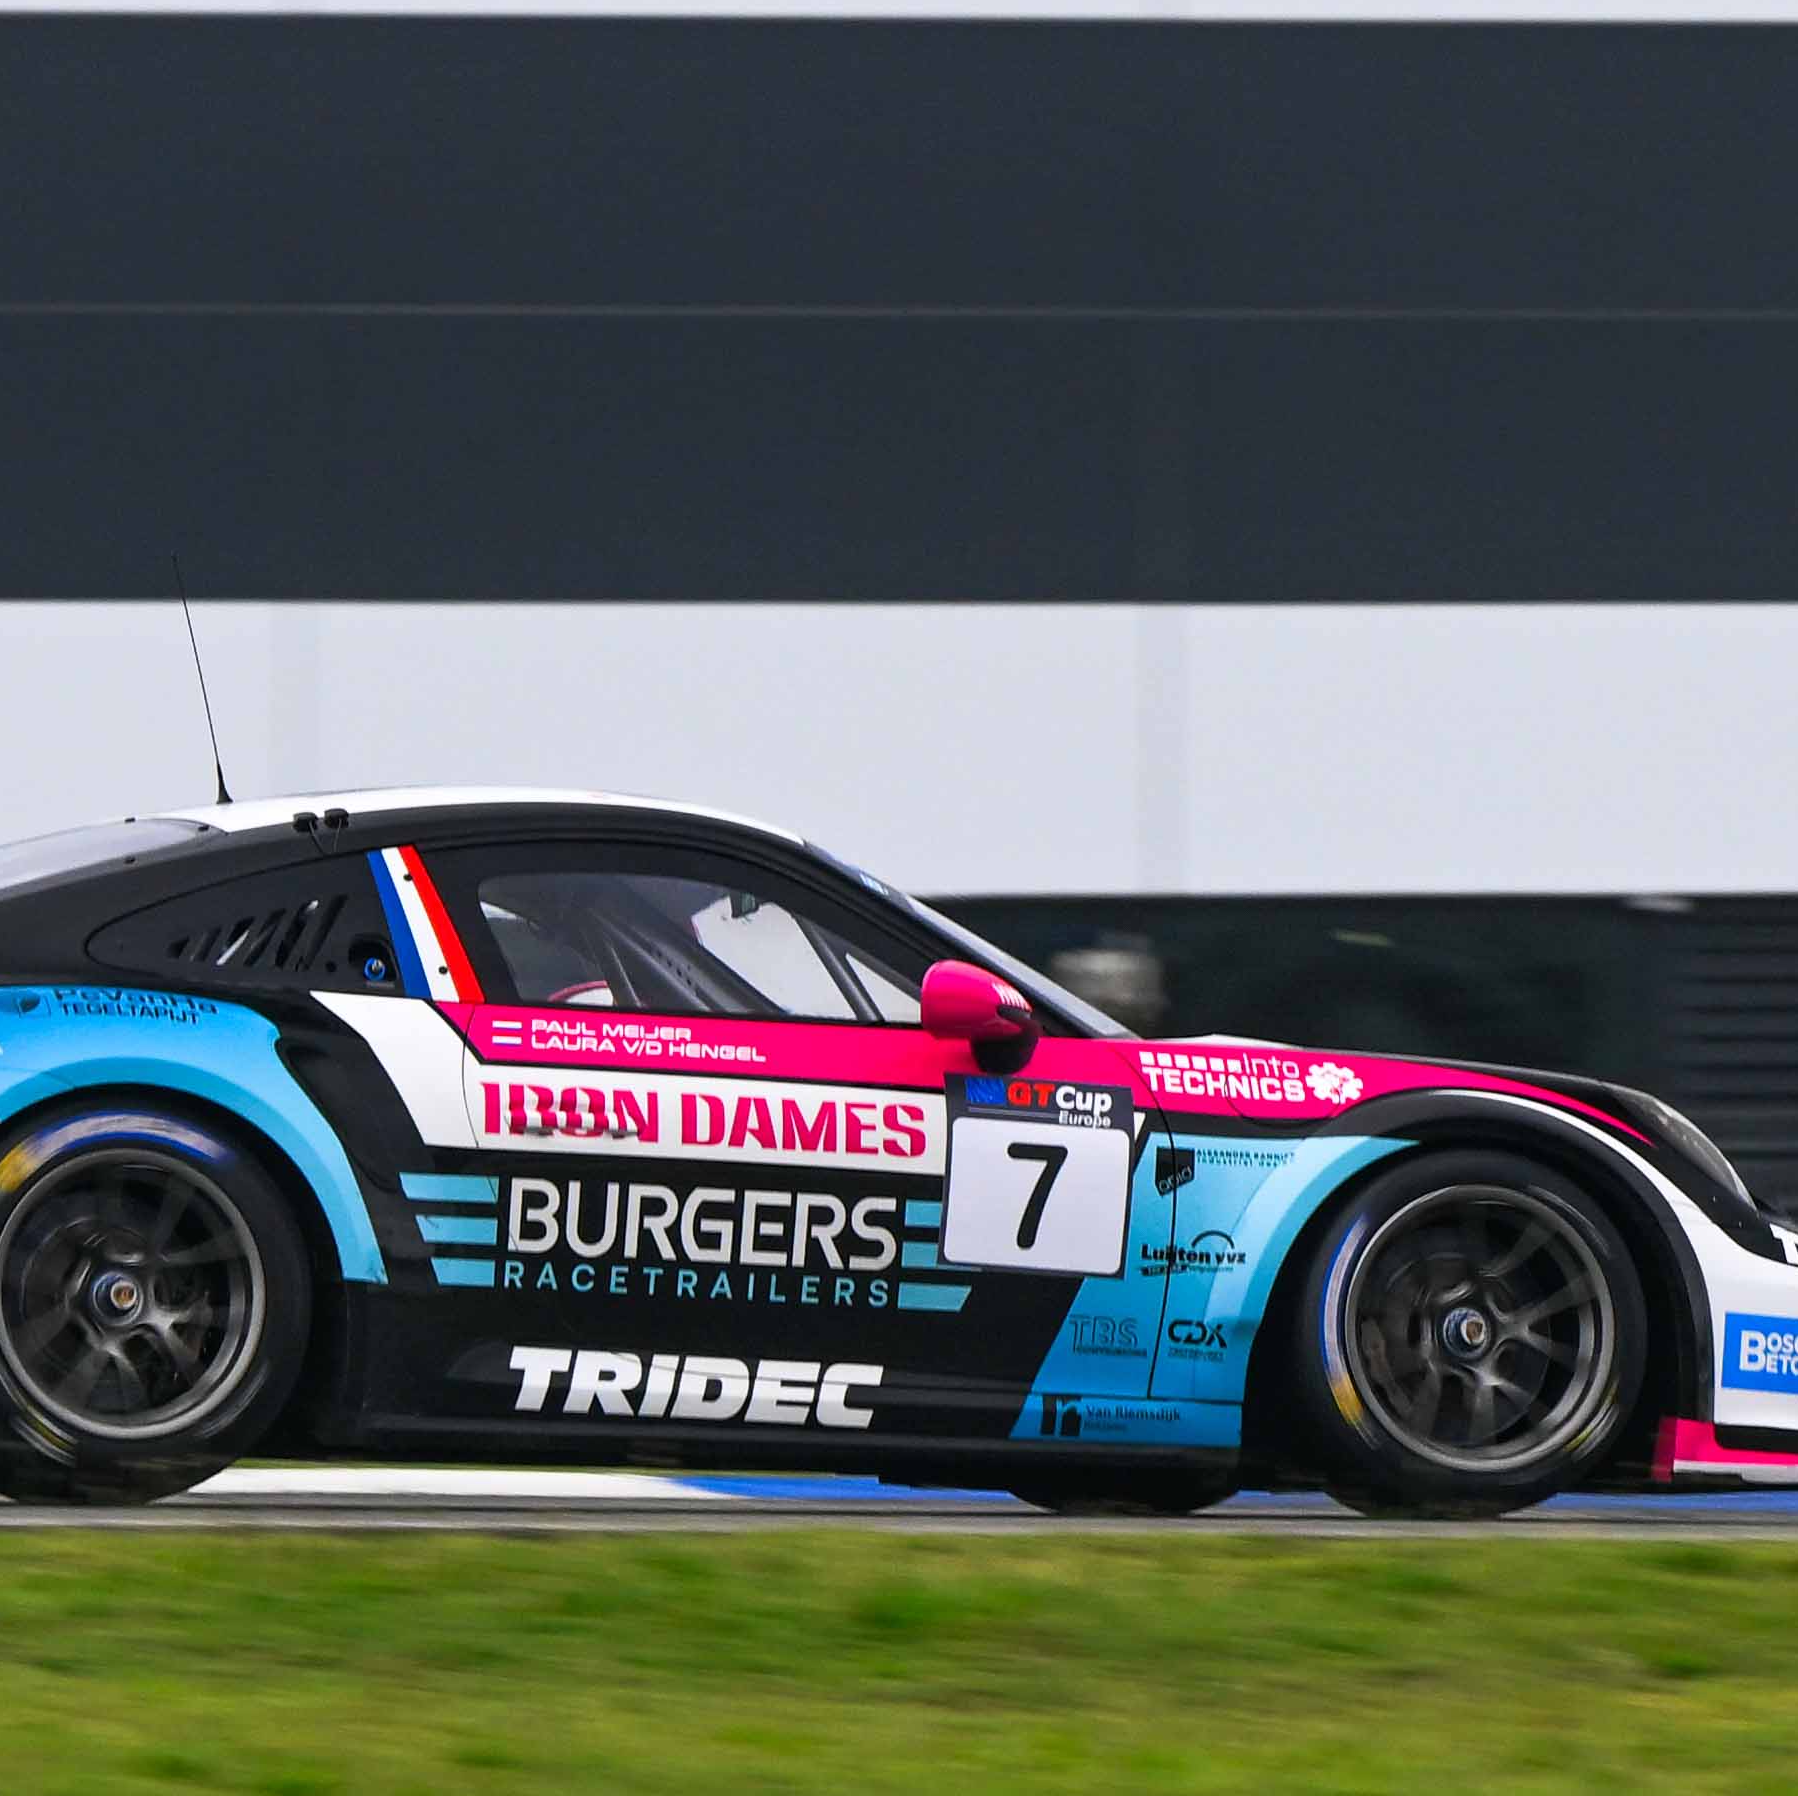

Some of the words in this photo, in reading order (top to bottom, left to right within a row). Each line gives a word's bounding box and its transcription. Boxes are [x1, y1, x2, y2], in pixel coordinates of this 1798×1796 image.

[531, 1019, 596, 1036] PAUL
[603, 1023, 691, 1041] MEIJER
[531, 1034, 616, 1052] LAURA
[624, 1039, 662, 1057] V/D
[668, 1043, 767, 1062] HENGEL
[1007, 1082, 1055, 1106] GT
[1056, 1086, 1113, 1115] Cup
[1141, 1067, 1306, 1103] TECHNICS
[480, 1082, 659, 1143] IRON
[681, 1093, 926, 1157] DAMES
[1058, 1110, 1112, 1128] Europe
[1006, 1142, 1068, 1248] 7
[509, 1177, 897, 1271] BURGERS
[503, 1262, 888, 1306] RACETRAILERS
[509, 1345, 884, 1428] TRIDEC
